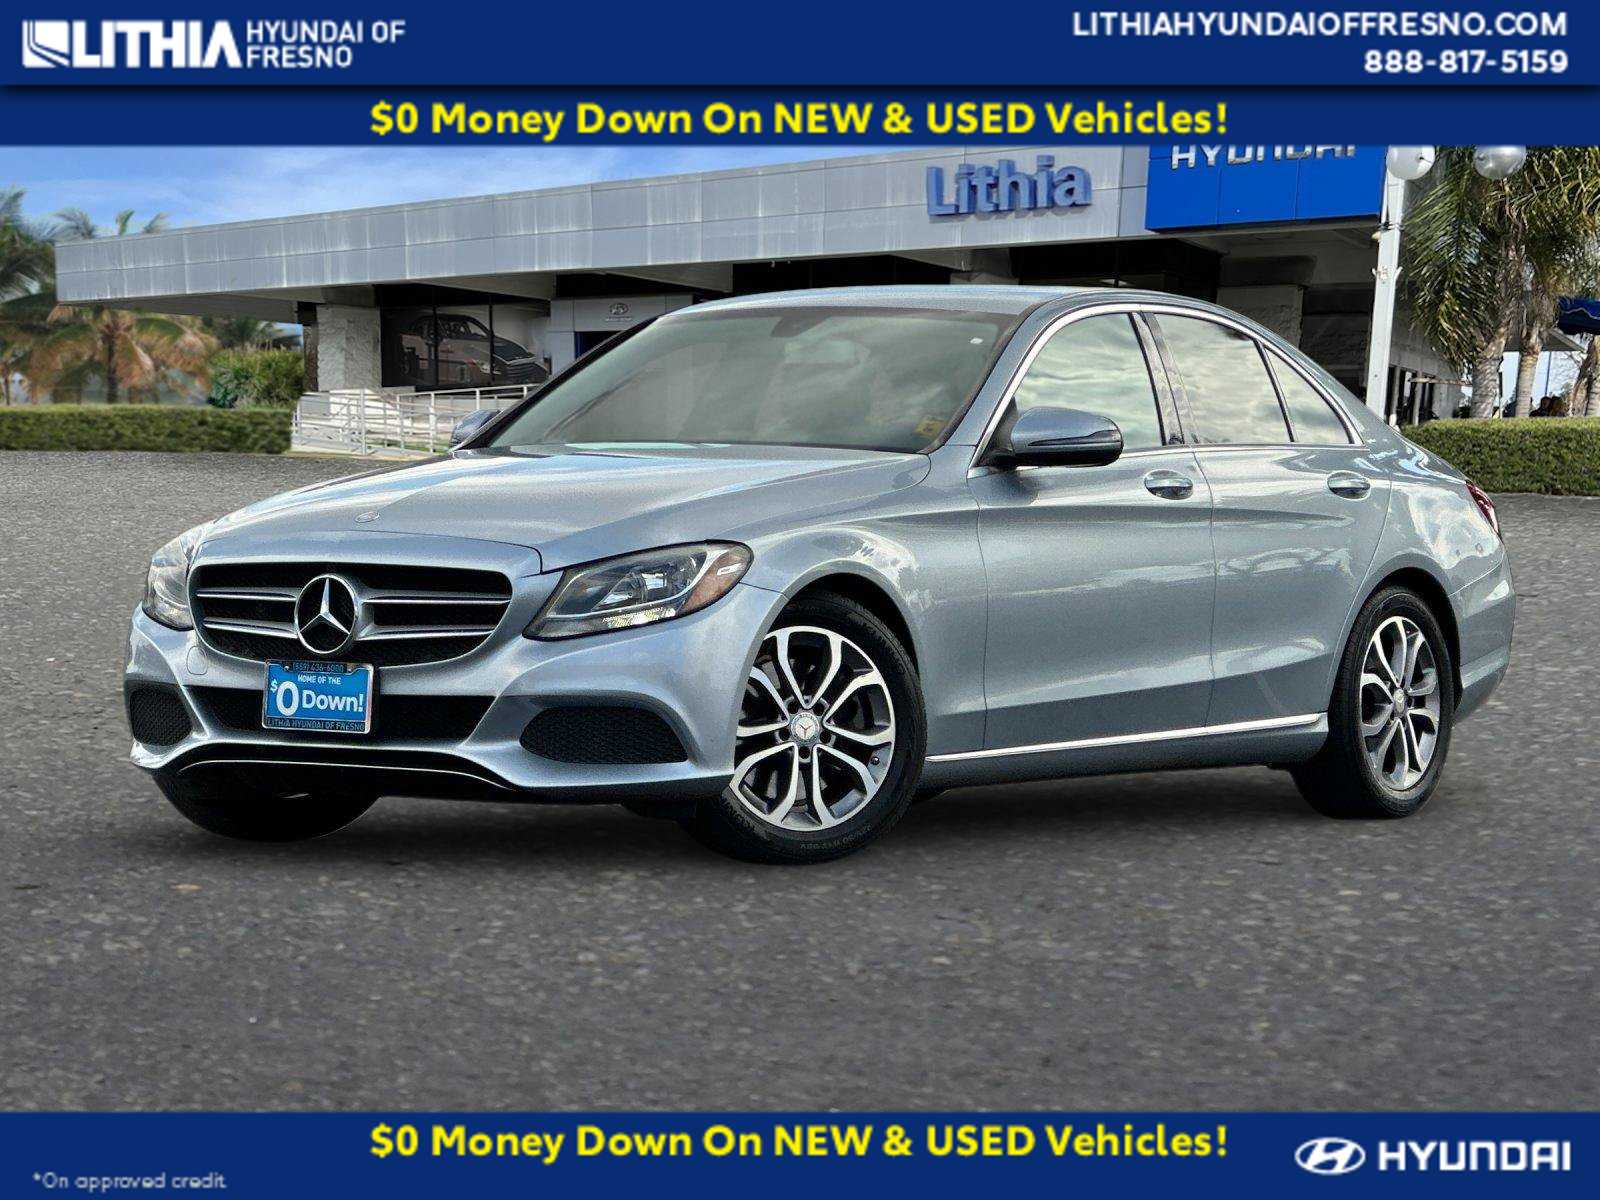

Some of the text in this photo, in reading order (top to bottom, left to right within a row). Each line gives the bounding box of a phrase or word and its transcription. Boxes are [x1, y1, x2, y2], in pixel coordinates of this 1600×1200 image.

[926, 154, 1092, 216] Lithia
[297, 674, 342, 685] HOME OF THE
[302, 690, 364, 713] Down!
